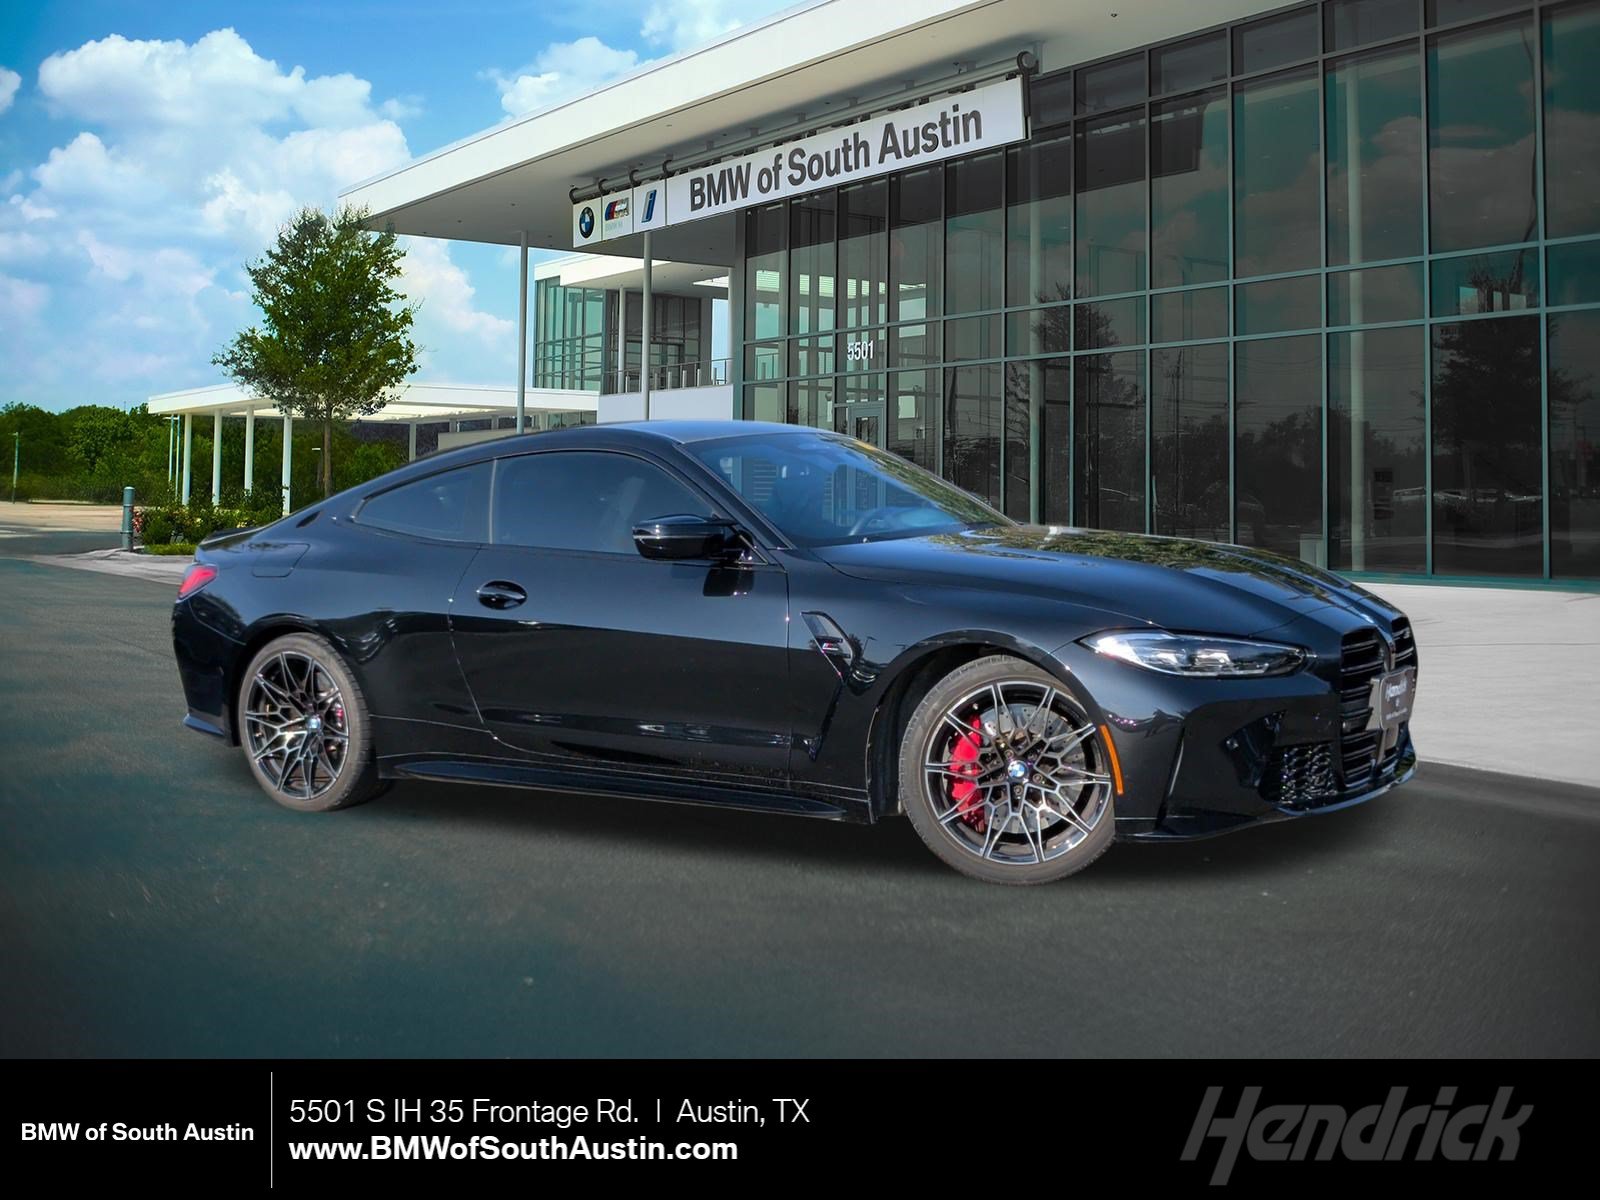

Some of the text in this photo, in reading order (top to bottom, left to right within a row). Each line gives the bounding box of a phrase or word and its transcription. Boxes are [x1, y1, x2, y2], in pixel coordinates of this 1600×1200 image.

[690, 104, 983, 212] BMW of South Austin
[847, 340, 874, 361] 5501
